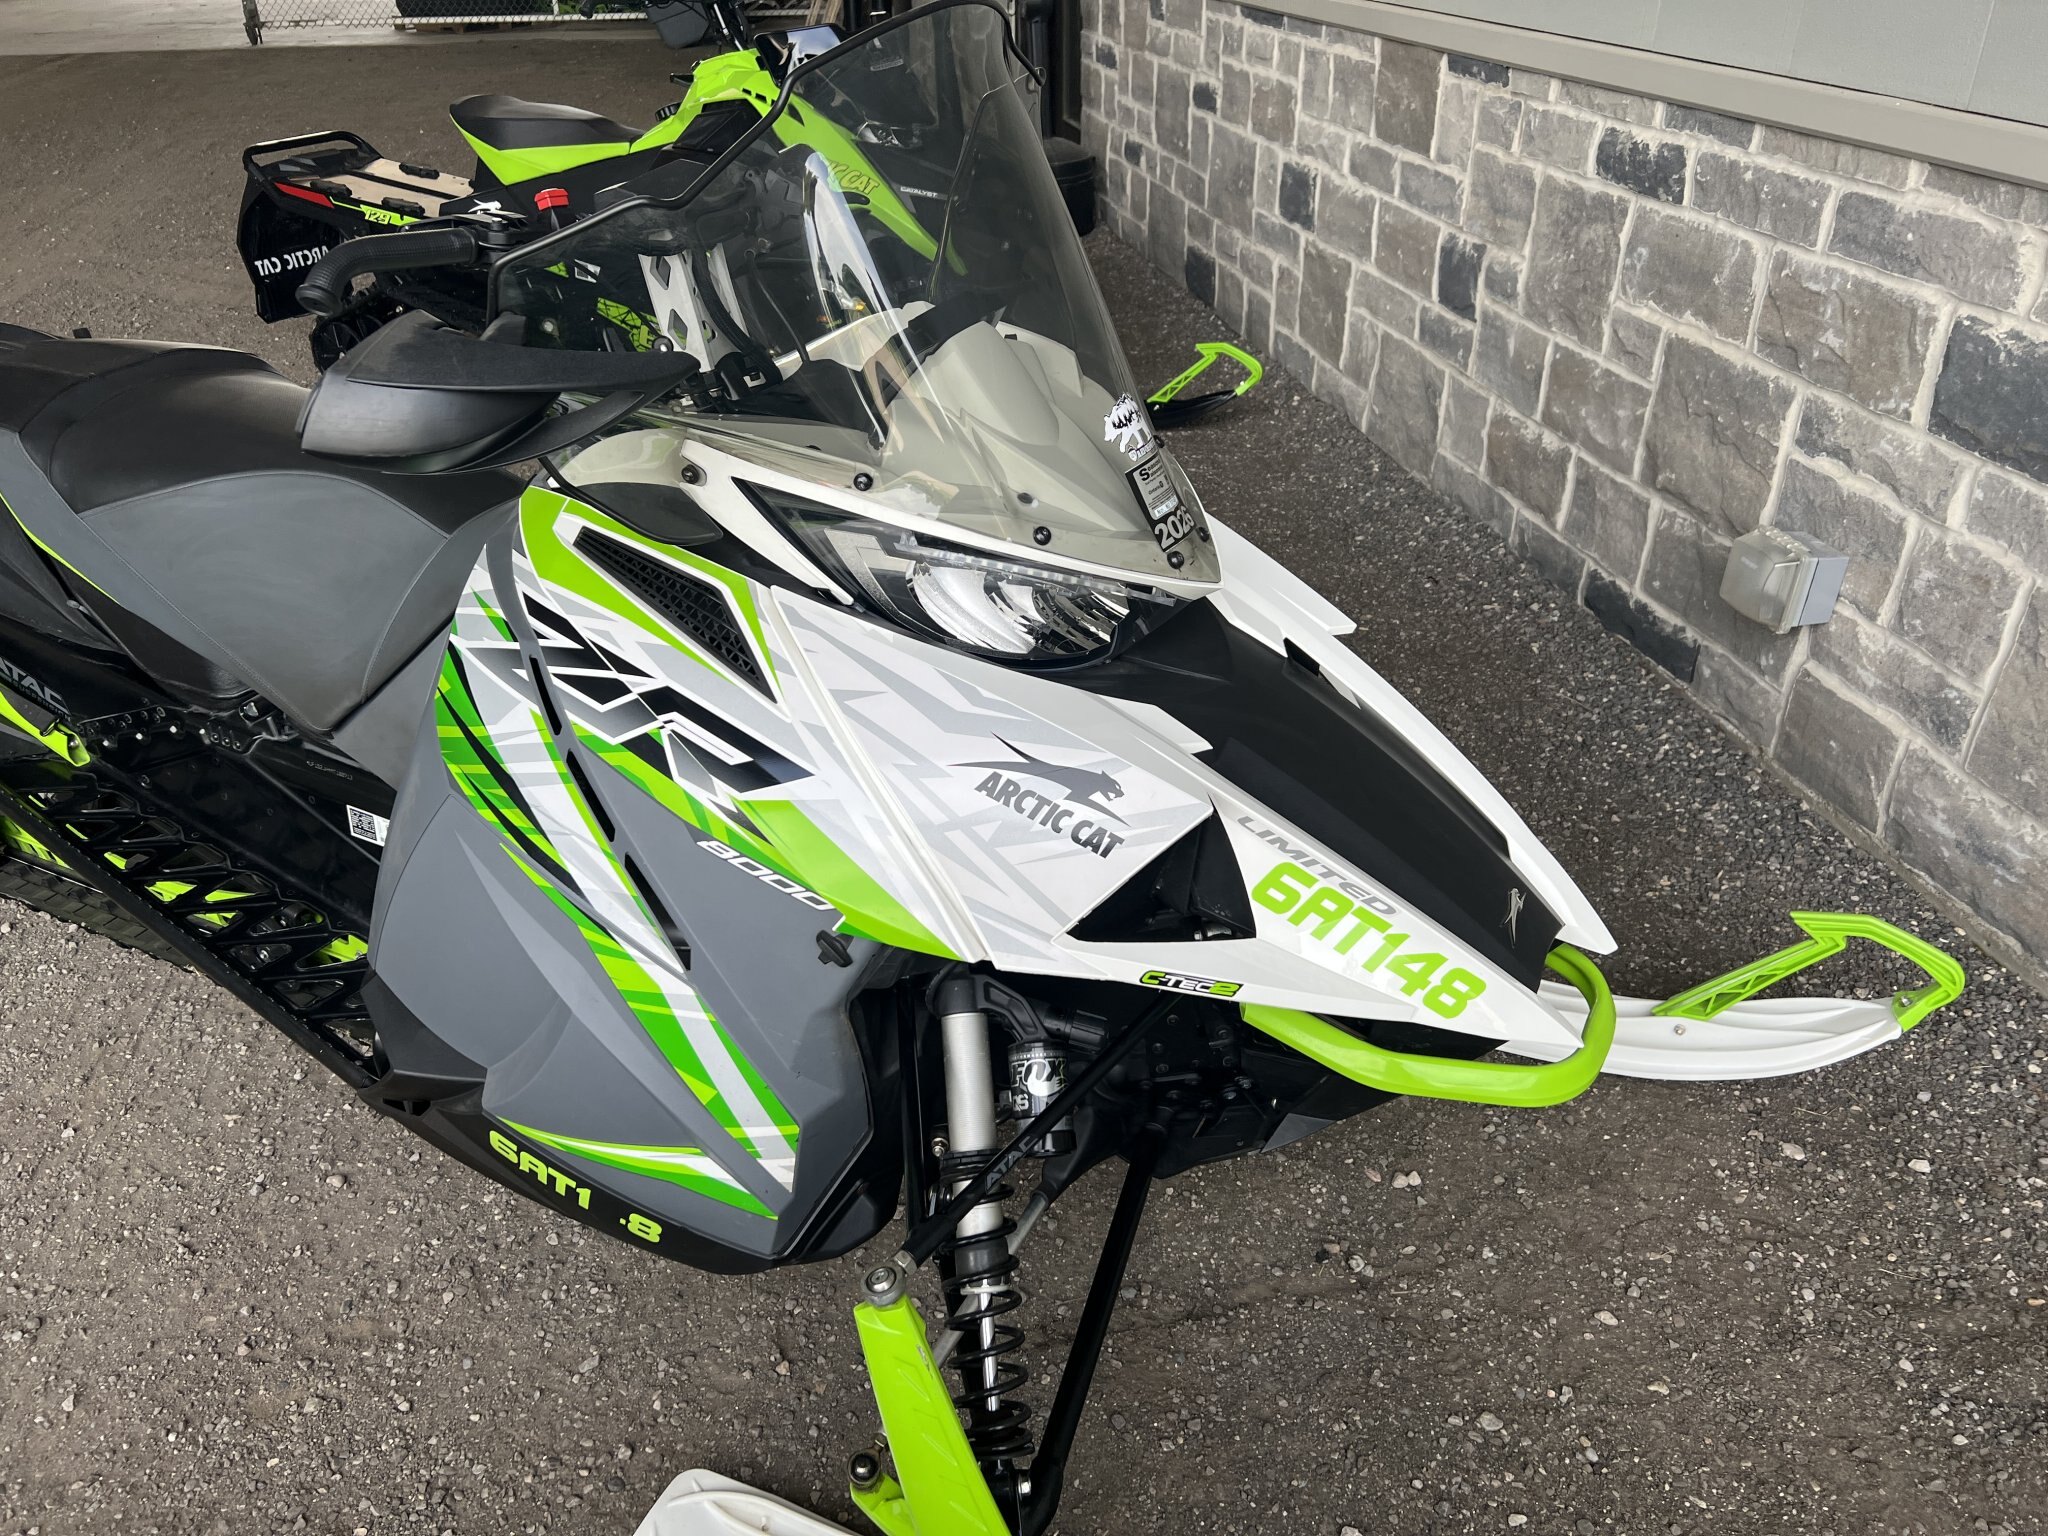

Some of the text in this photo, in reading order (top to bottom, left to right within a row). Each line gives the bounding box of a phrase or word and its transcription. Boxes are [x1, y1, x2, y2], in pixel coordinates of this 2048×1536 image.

[900, 186, 938, 198] CATALYST
[1154, 506, 1195, 549] 2026
[974, 771, 1125, 859] ARCTIC CAT
[697, 840, 836, 911] 8000
[1237, 815, 1398, 916] LIMITED
[1251, 861, 1487, 1019] 6AT148
[1011, 1058, 1067, 1087] FOX
[986, 1136, 1038, 1190] ATAC
